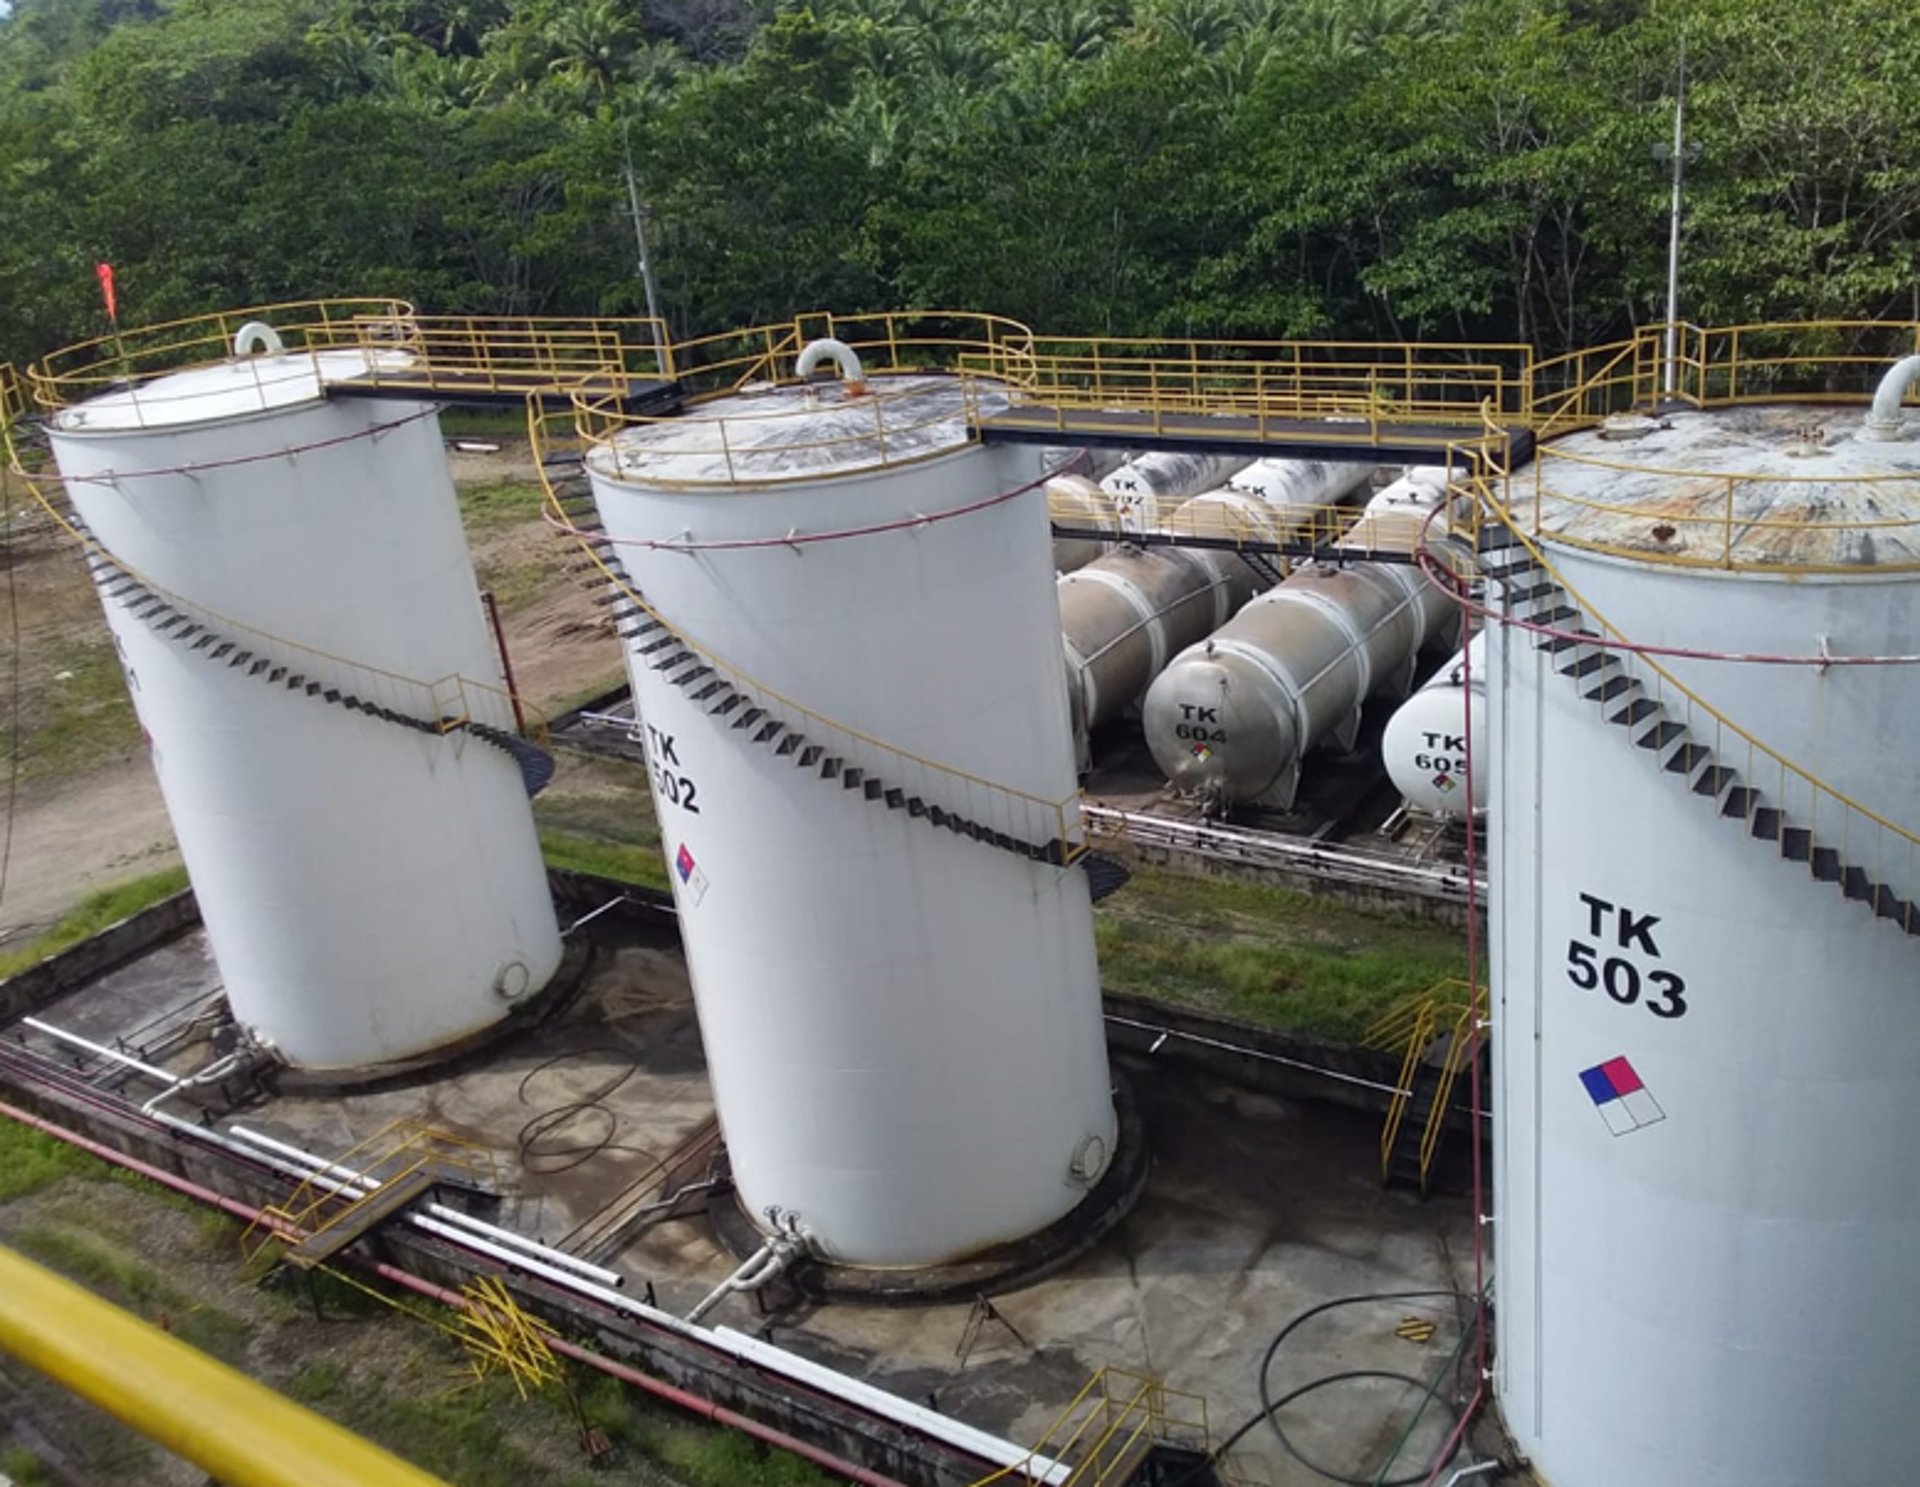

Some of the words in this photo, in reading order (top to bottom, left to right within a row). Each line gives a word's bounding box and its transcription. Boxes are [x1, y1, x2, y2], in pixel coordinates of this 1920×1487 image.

[1112, 479, 1137, 491] TK
[1179, 704, 1217, 724] TK
[1175, 723, 1227, 744] 604
[1422, 732, 1464, 751] TK
[648, 723, 680, 766] TK
[1579, 892, 1661, 958] TK
[1567, 939, 1687, 1018] 503
